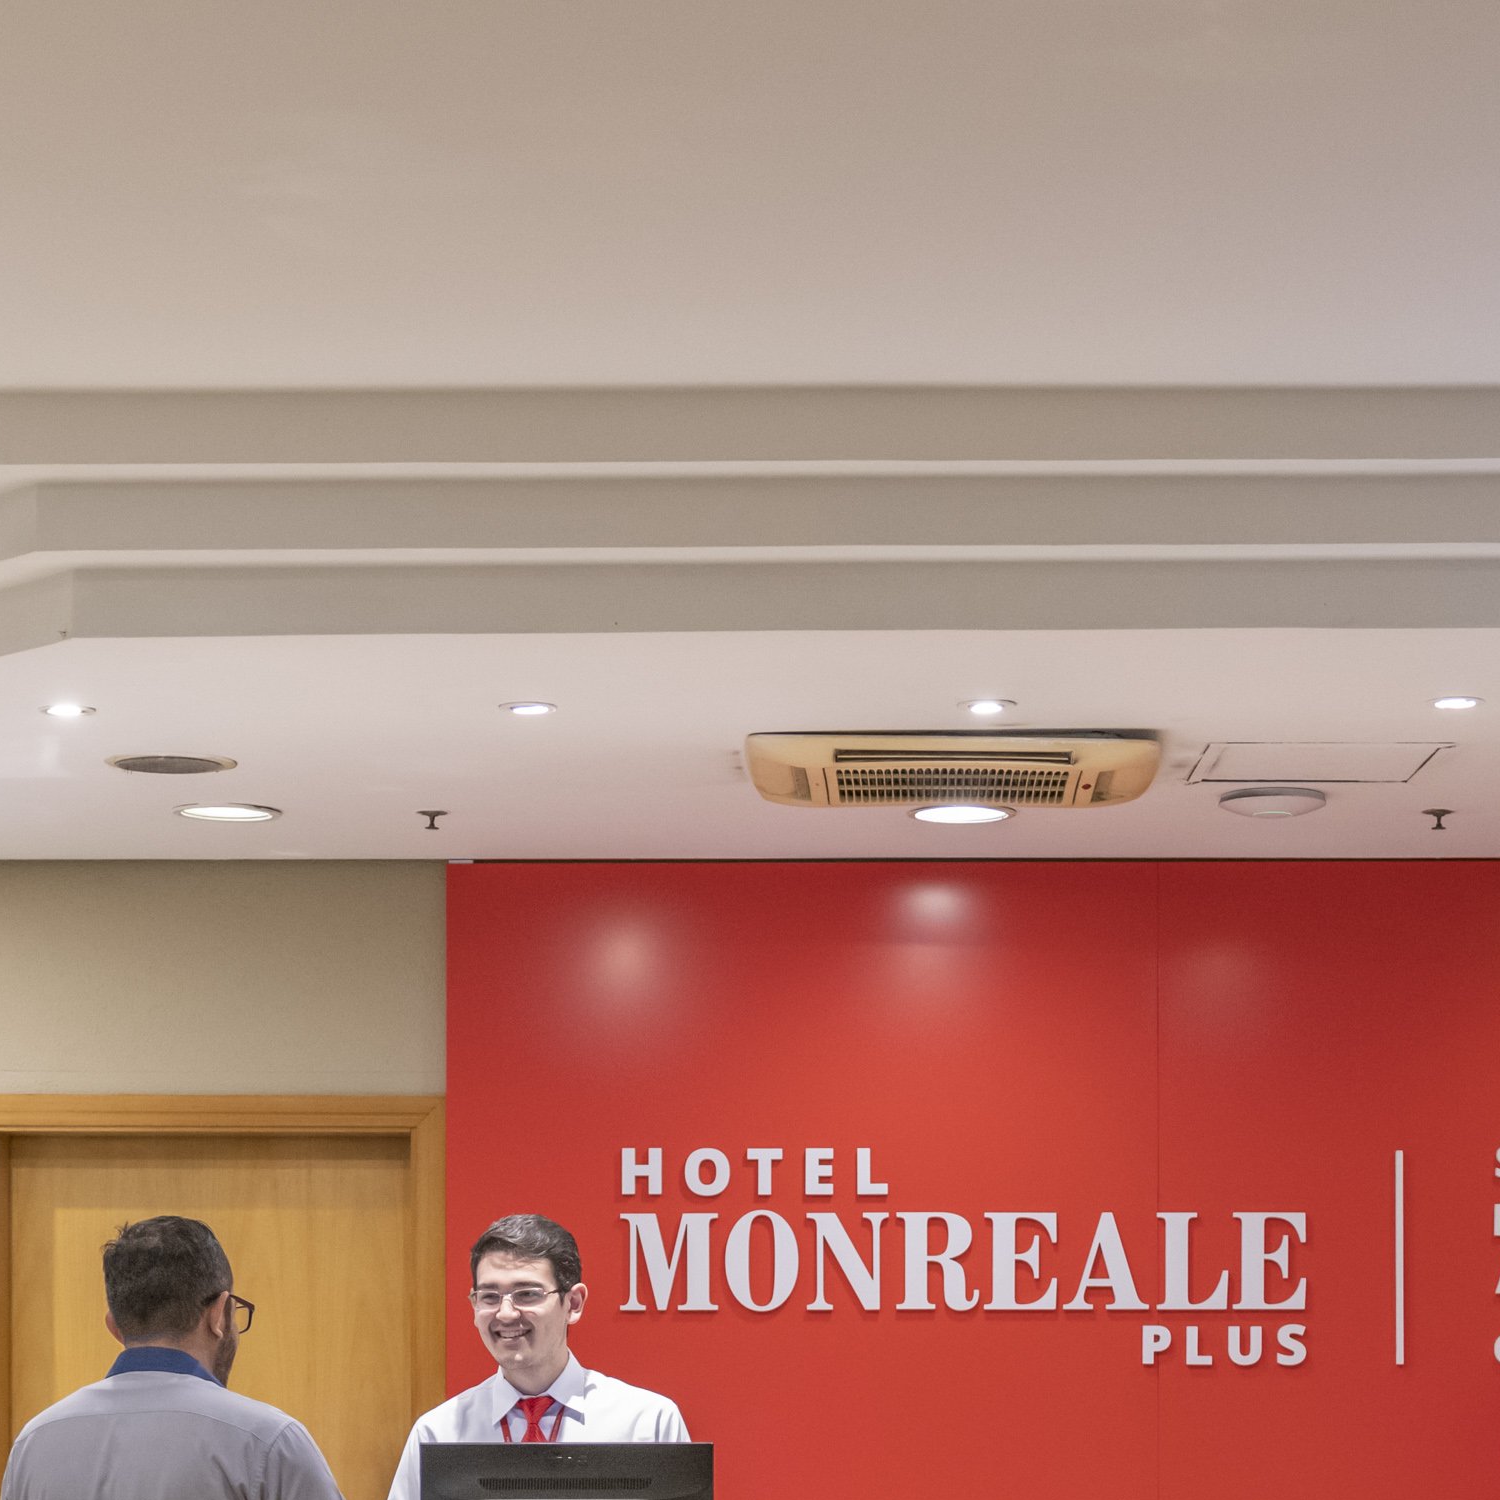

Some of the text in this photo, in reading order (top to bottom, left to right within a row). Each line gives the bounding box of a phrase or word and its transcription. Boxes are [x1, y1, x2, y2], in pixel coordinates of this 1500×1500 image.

[621, 1147, 888, 1196] HOTEL
[620, 1210, 1306, 1312] MONREALE
[1142, 1323, 1307, 1366] PLUS
